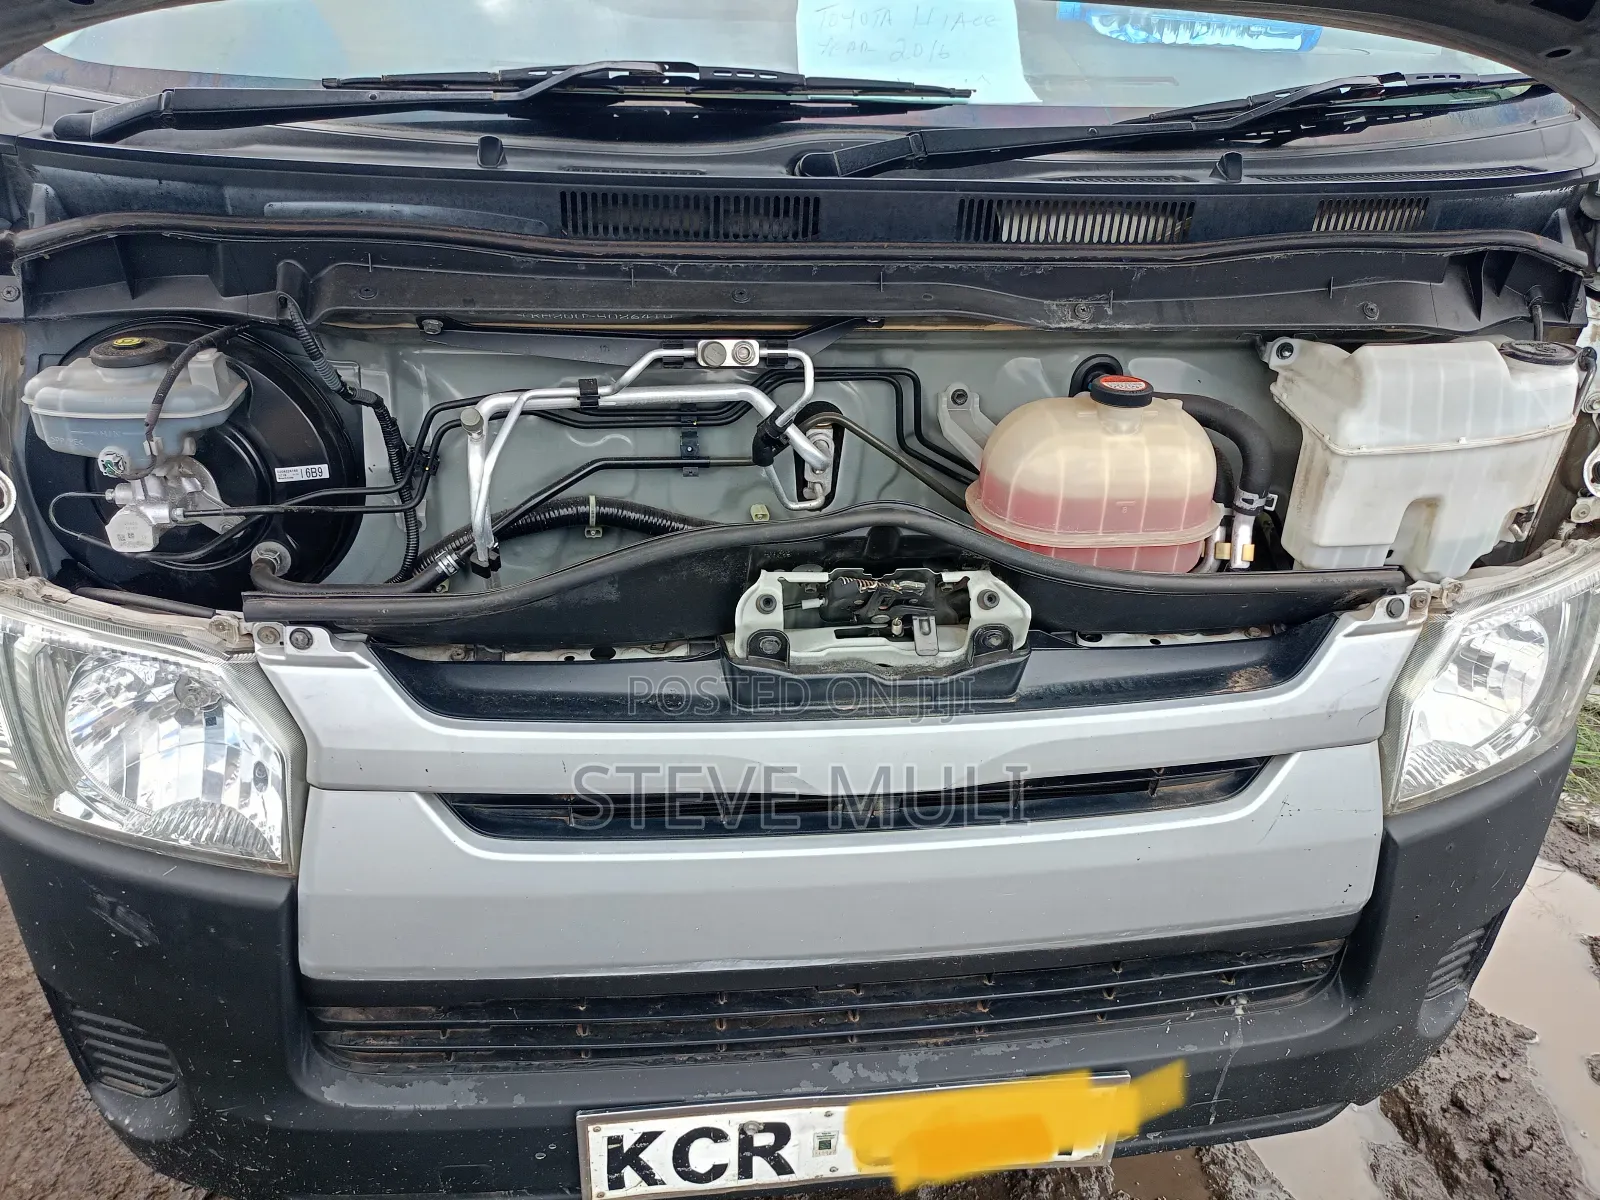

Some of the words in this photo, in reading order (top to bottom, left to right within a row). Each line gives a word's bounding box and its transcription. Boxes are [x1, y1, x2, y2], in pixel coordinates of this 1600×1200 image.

[814, 4, 892, 33] TOYOTA
[818, 37, 877, 57] YEAR
[889, 37, 950, 62] 2016
[305, 466, 323, 478] 6B9
[606, 1121, 796, 1191] KCR
